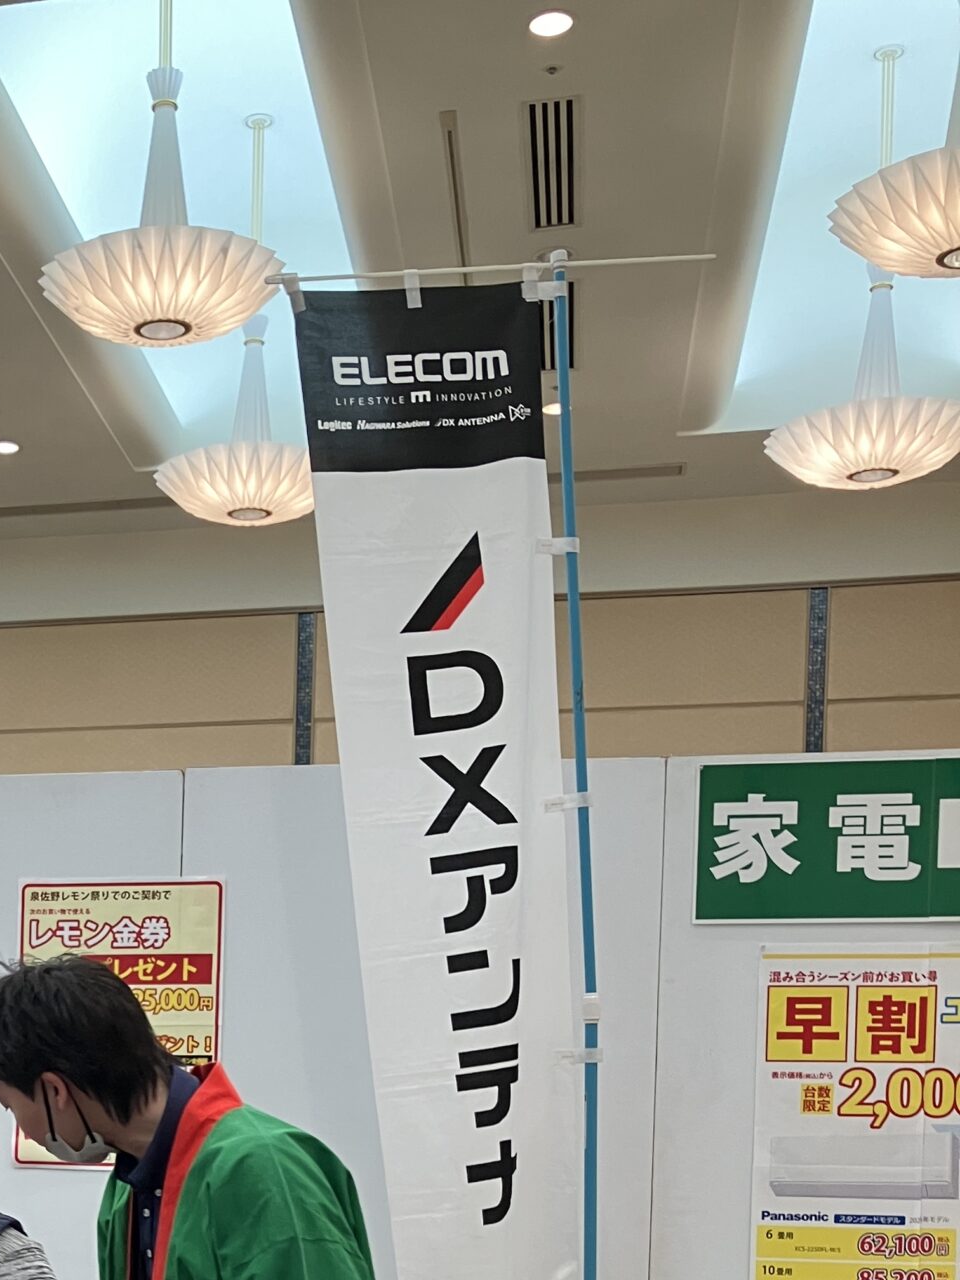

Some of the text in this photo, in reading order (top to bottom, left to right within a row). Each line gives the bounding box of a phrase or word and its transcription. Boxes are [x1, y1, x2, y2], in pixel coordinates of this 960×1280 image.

[332, 349, 510, 386] ELECOM
[335, 394, 406, 406] LIFESTYLE
[436, 385, 514, 402] INNOVATION
[458, 411, 506, 427] ANTENNA
[709, 792, 960, 883] 家電
[30, 889, 172, 902] 泉佐野レモン祭りでのご契約で
[28, 915, 171, 949] レモン金券
[406, 649, 520, 1227] DXアンテナ
[103, 956, 198, 982] レゼント
[776, 994, 929, 1056] 早割
[802, 1084, 832, 1099] 台数
[837, 1066, 960, 1130] 2,00
[802, 1099, 832, 1113] 限定
[761, 1210, 829, 1222] Panasonic
[839, 1216, 901, 1225] スタンダードモデル
[765, 1229, 773, 1239] 6
[858, 1232, 936, 1259] 62,100
